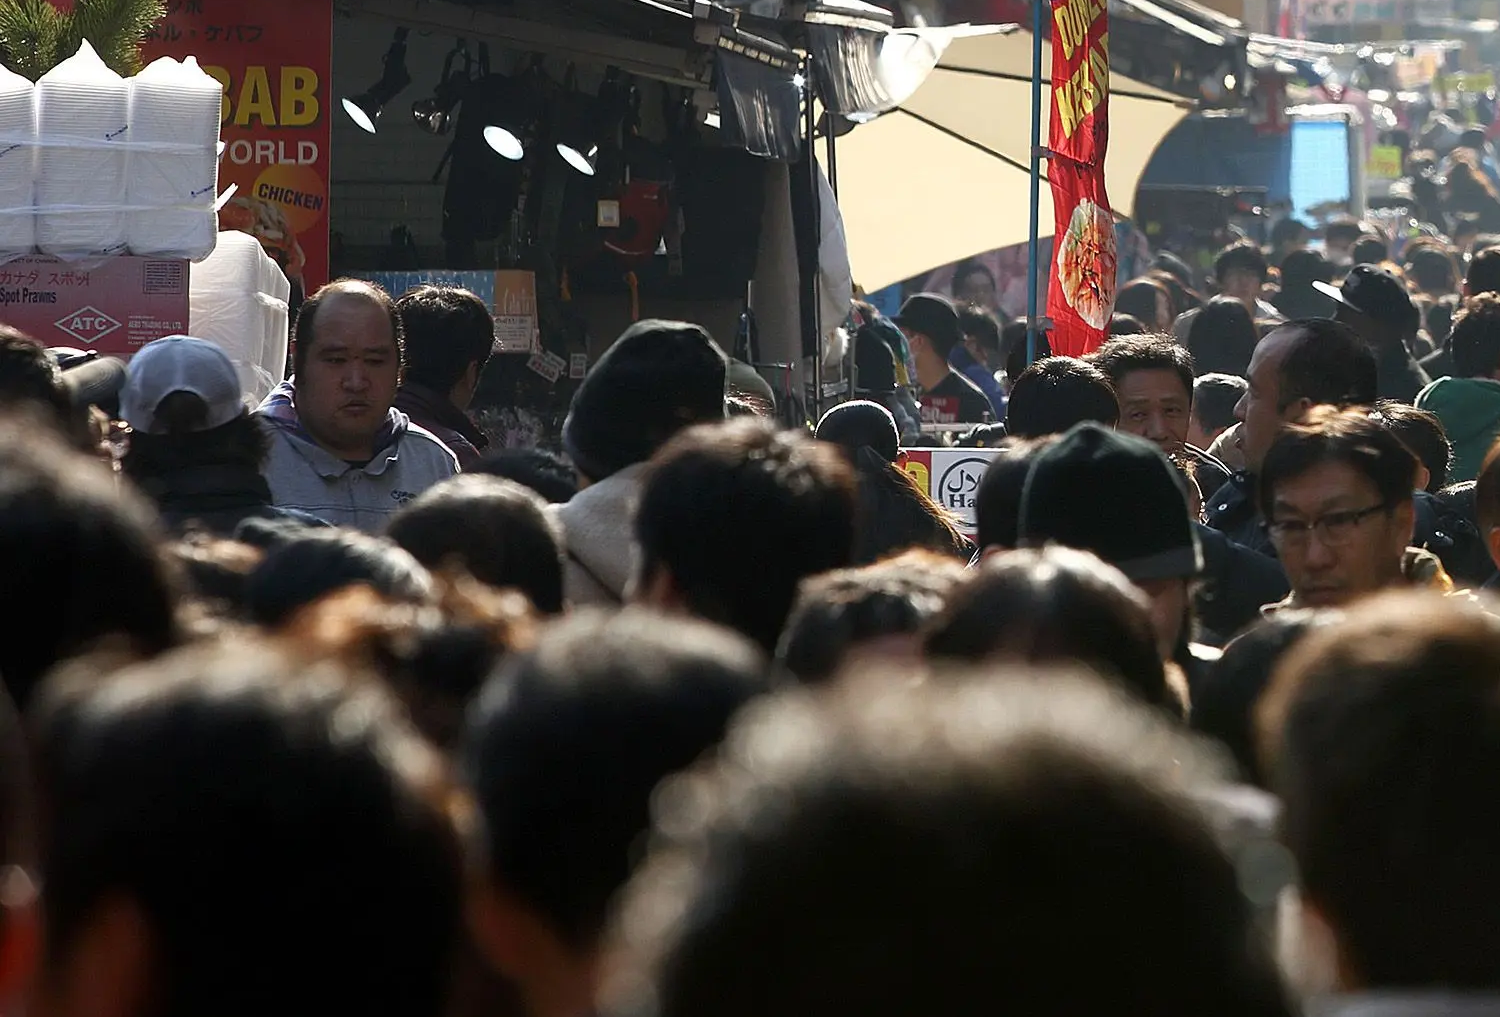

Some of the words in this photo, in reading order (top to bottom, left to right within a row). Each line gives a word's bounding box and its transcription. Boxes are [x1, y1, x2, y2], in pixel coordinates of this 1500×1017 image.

[219, 139, 319, 166] ORLD
[257, 182, 324, 212] CHICKEN
[0, 270, 38, 285] カナダ
[0, 287, 19, 306] Spot
[22, 287, 57, 304] Prawns
[70, 317, 107, 330] ATC
